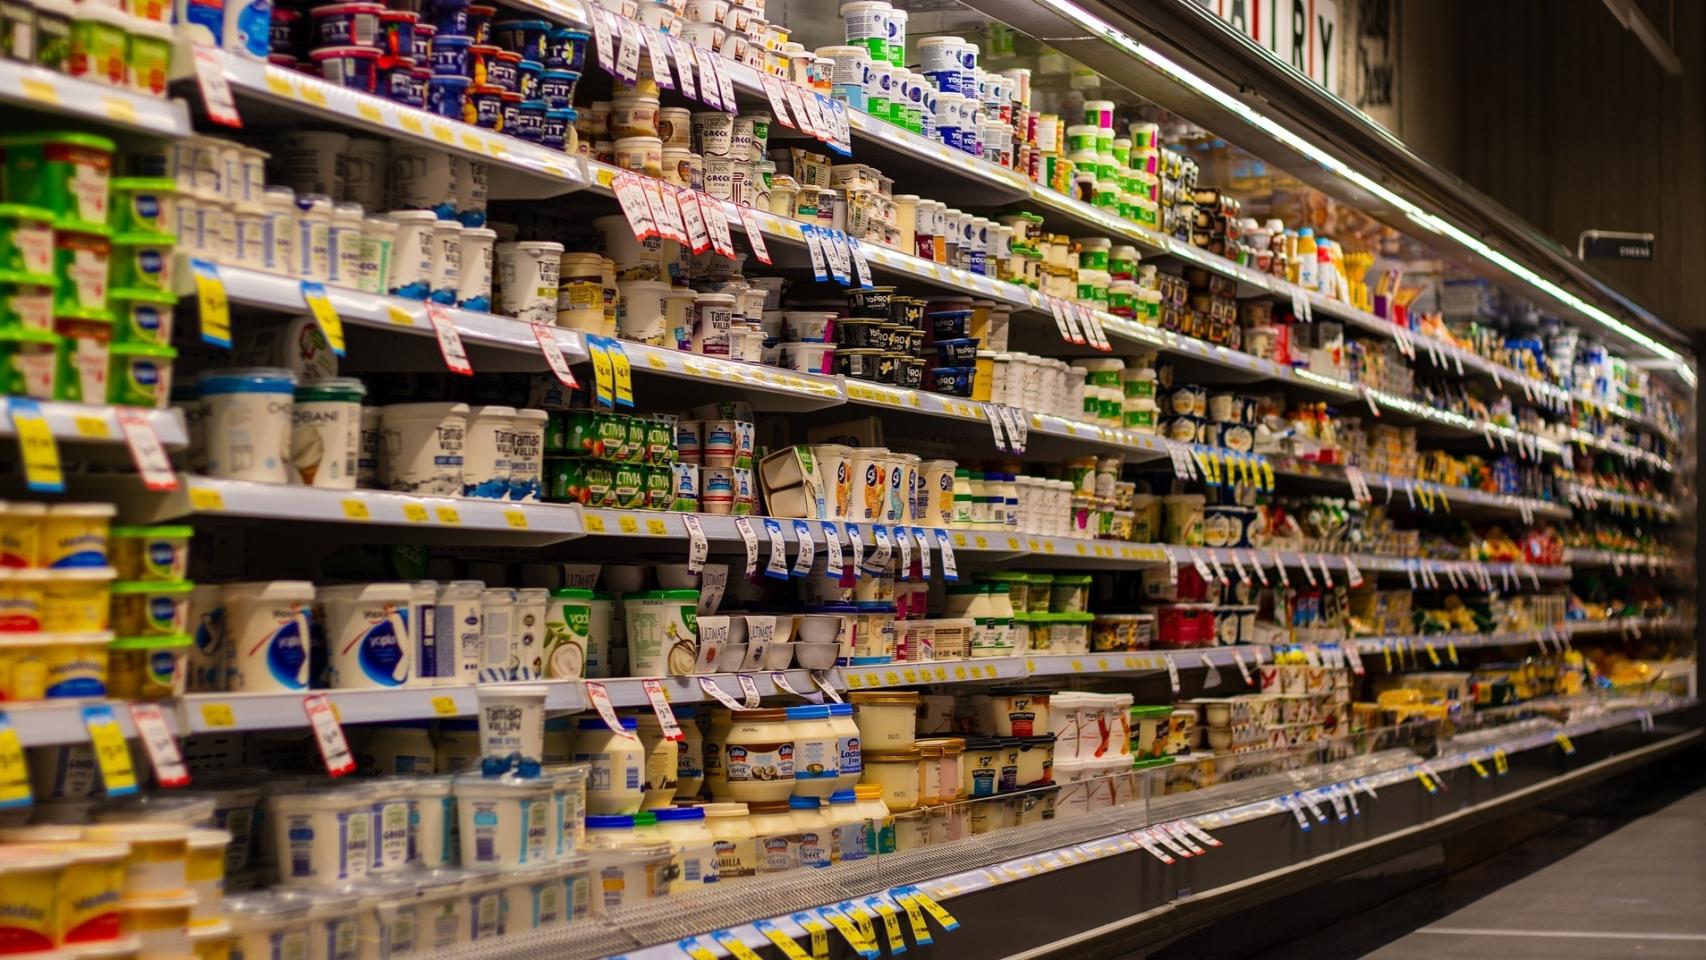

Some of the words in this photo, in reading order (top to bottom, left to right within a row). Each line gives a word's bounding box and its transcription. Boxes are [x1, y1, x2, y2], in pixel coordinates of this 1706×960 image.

[1206, 0, 1333, 87] AIRY
[617, 472, 642, 485] CTIVIA
[701, 626, 727, 642] ULTIMATE
[750, 625, 773, 641] ULTIMATE
